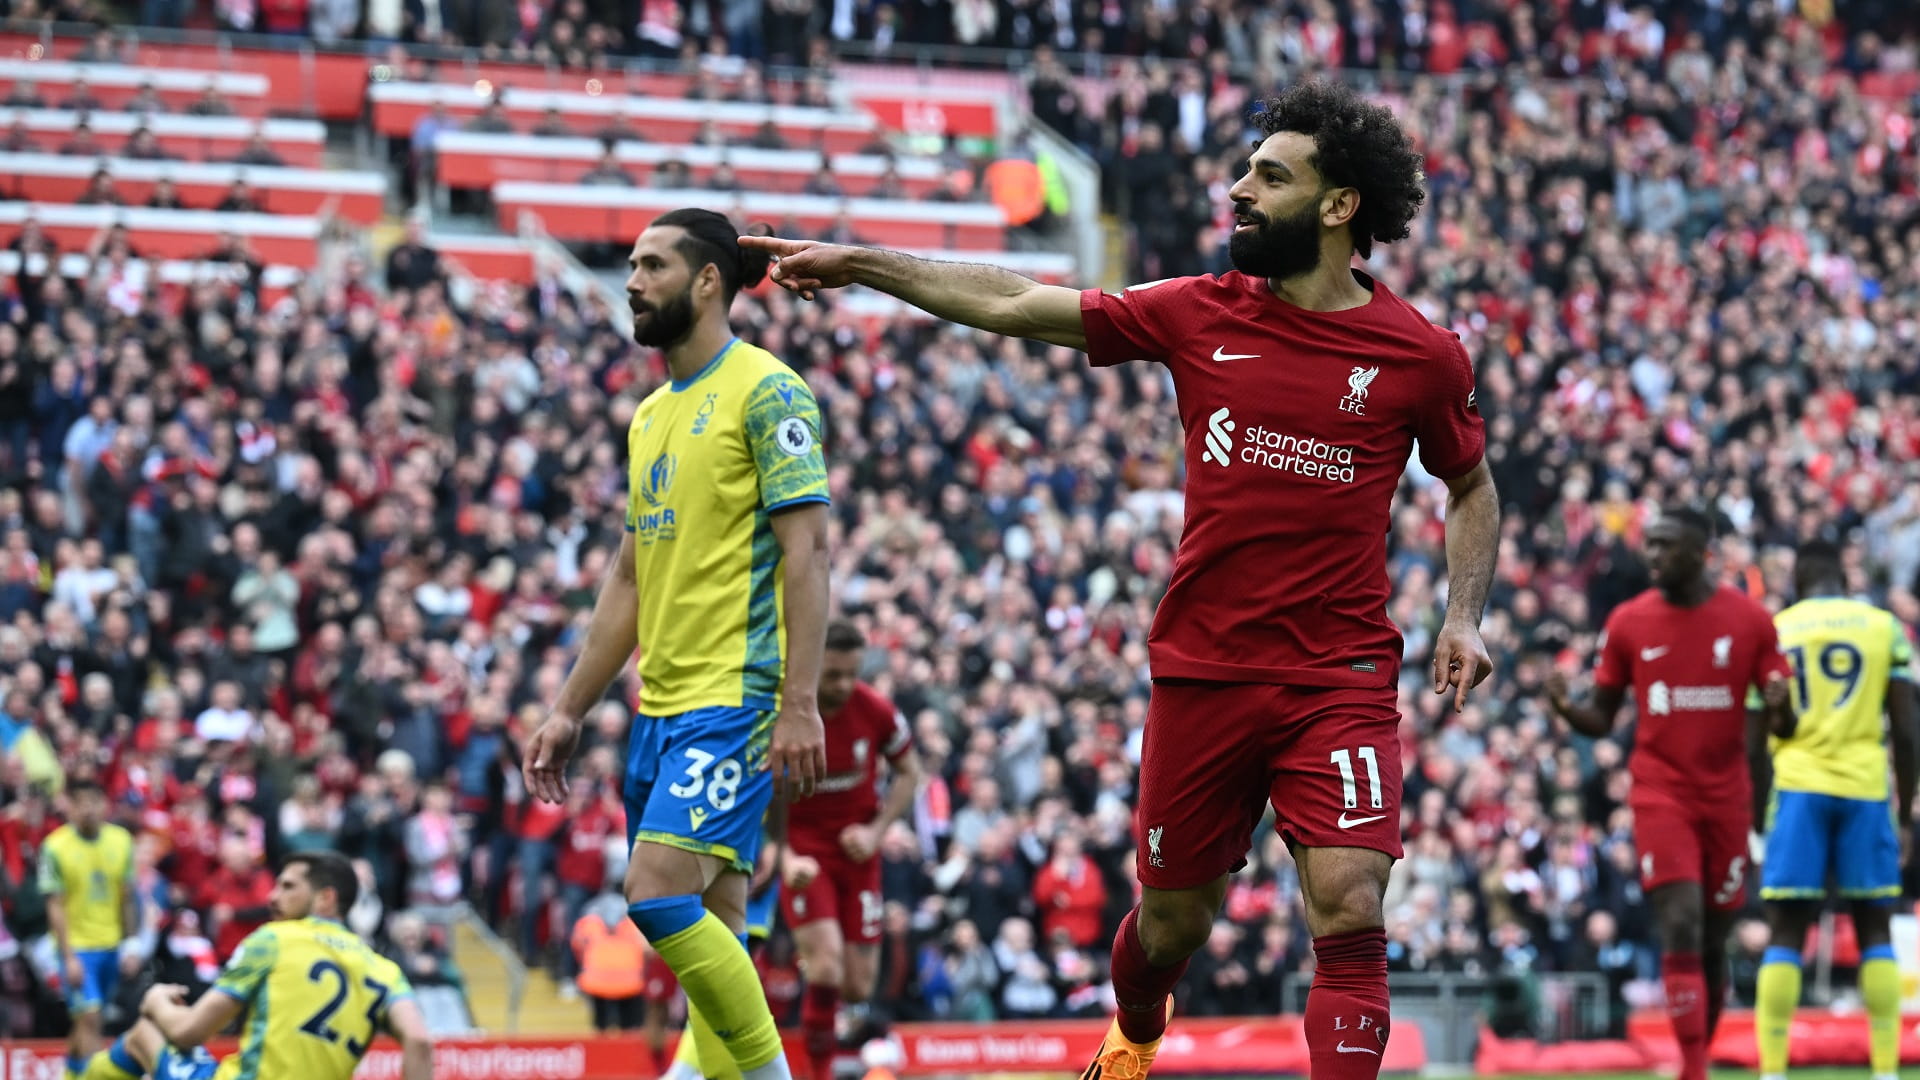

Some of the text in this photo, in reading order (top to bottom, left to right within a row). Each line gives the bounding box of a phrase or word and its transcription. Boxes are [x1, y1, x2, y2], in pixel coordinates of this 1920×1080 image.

[1240, 446, 1355, 483] chartered
[1244, 425, 1354, 466] standard
[1787, 642, 1863, 713] 19
[668, 747, 743, 811] 38
[1331, 746, 1382, 809] 11
[299, 959, 389, 1057] 23
